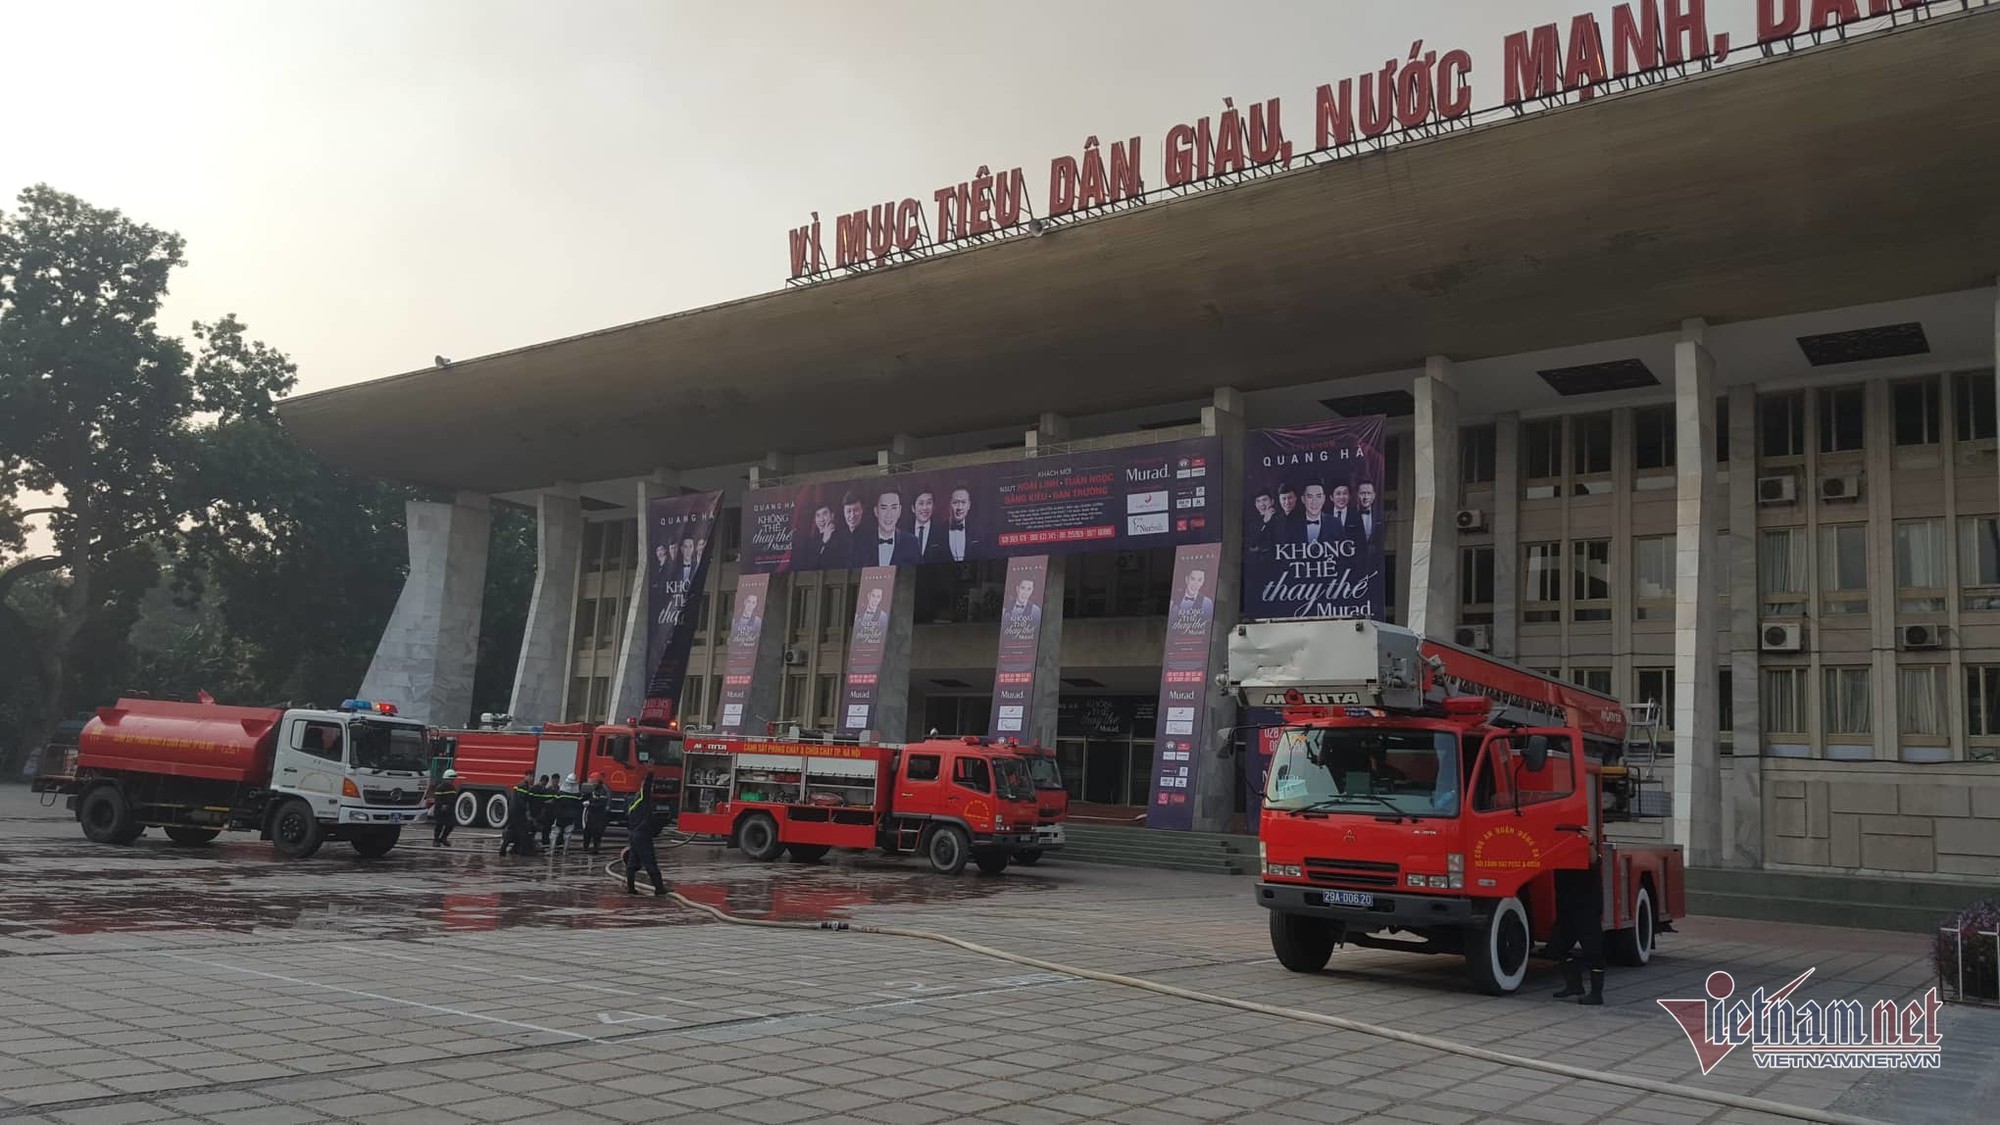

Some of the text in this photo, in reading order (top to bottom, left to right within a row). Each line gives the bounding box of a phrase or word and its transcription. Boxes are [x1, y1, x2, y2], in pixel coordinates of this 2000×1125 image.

[789, 211, 820, 278] VÌ
[836, 197, 919, 267] MỤC
[934, 165, 1022, 244] TIÊU
[1049, 136, 1141, 218] DÂN
[1165, 97, 1293, 187] GIÀU,
[1316, 39, 1472, 150] NƯỚC
[1503, 0, 1729, 101] MẠNH,
[1263, 450, 1328, 467] QUANG
[1275, 540, 1356, 560] KHÔNG
[1289, 554, 1339, 579] THỂ
[1262, 571, 1325, 618] thay
[1263, 688, 1360, 706] MORITA
